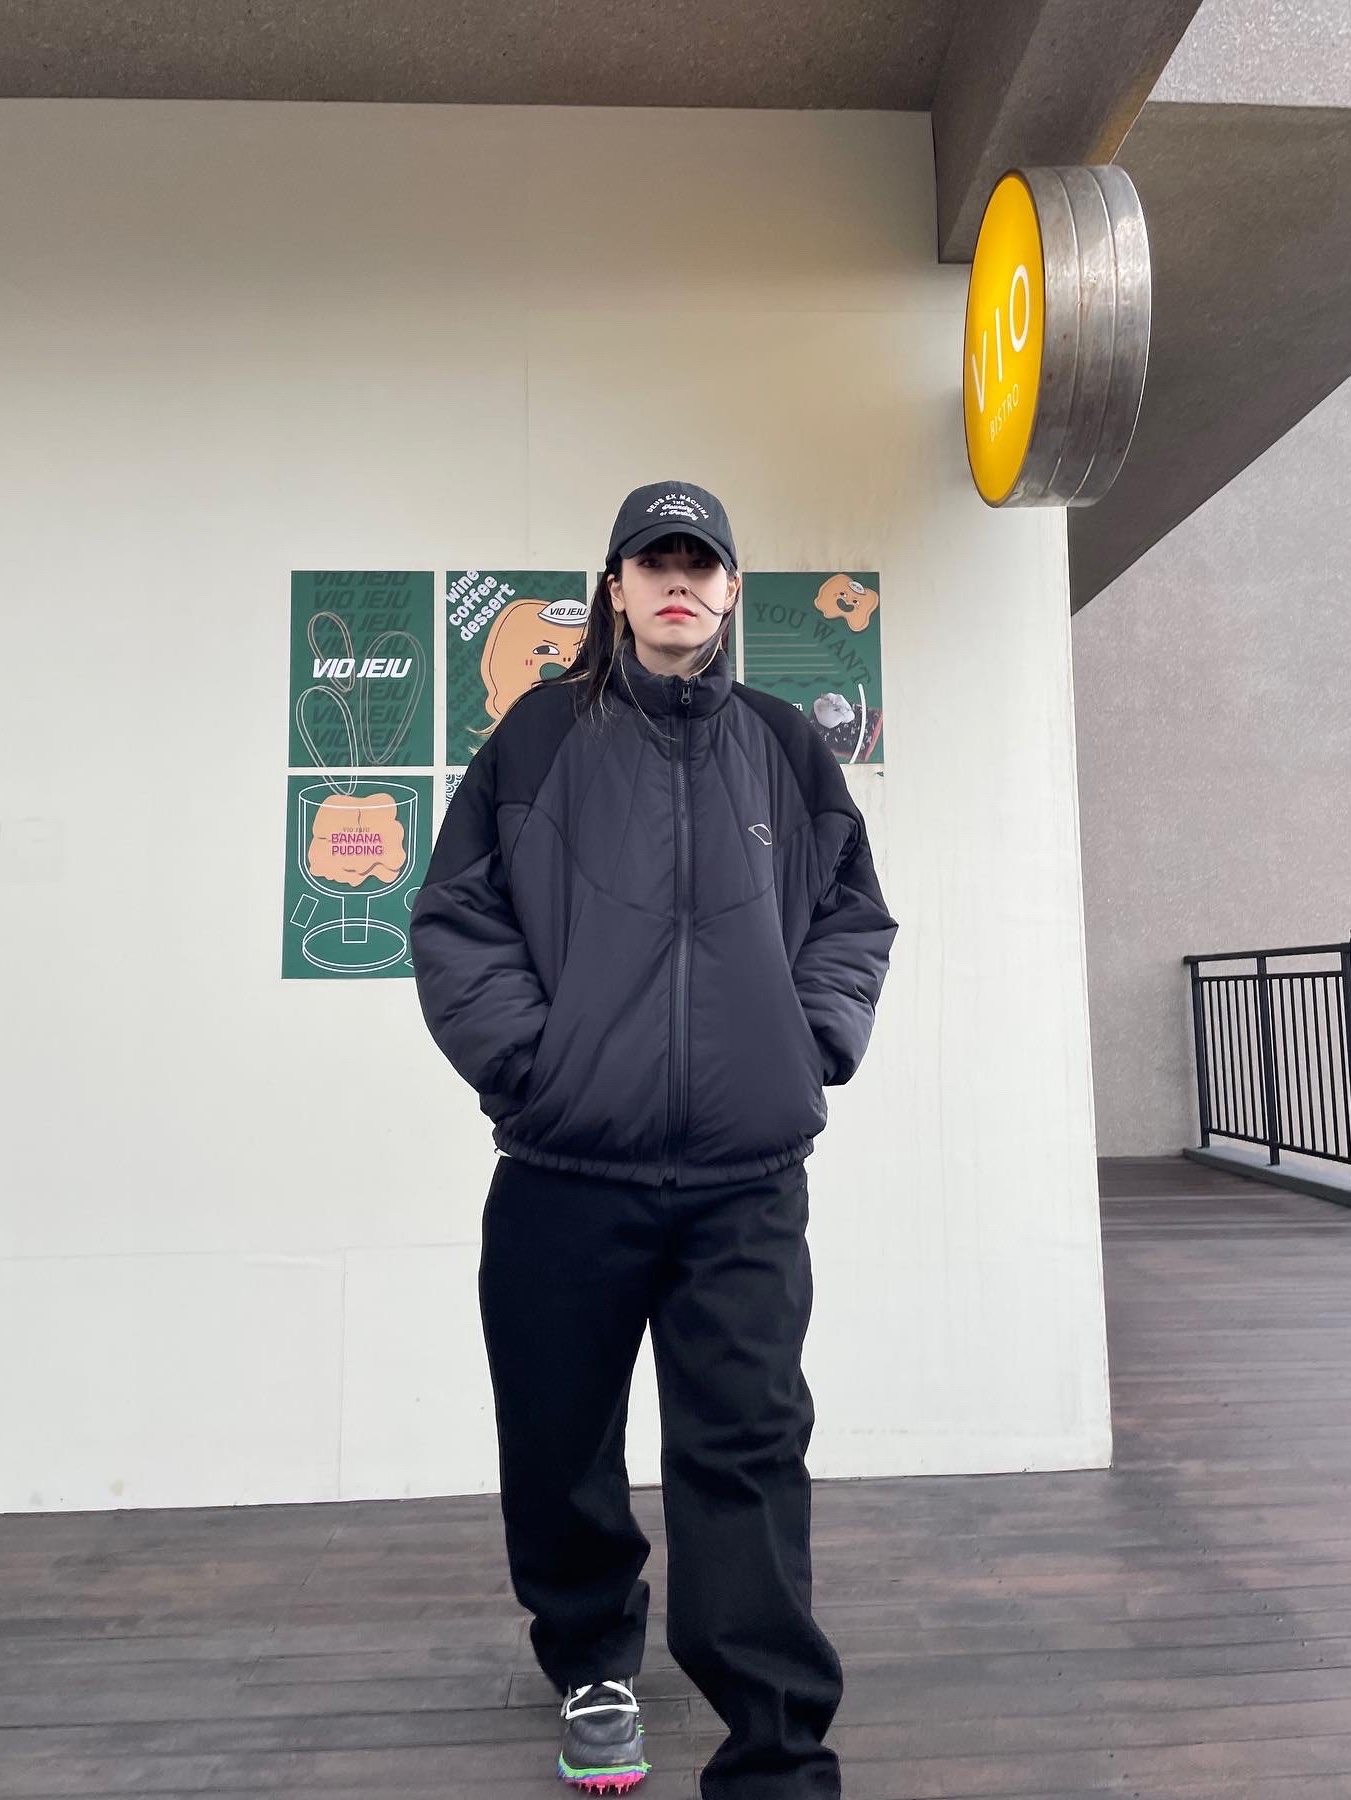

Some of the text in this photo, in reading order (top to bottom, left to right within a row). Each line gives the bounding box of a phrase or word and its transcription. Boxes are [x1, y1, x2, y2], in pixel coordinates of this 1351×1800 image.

[972, 264, 1030, 413] VIO
[989, 383, 1020, 443] BISTRO
[646, 498, 664, 513] DEUS
[680, 494, 709, 519] MACHINA
[315, 590, 355, 608] VIO
[446, 569, 480, 603] wine
[450, 576, 497, 626] coffee
[460, 583, 516, 641] dessert
[550, 607, 587, 616] VIO JEJU
[753, 602, 871, 686] YOU WANT
[312, 658, 412, 678] VIO JEJU
[331, 833, 382, 843] BANANA
[331, 845, 383, 855] PUDDING
